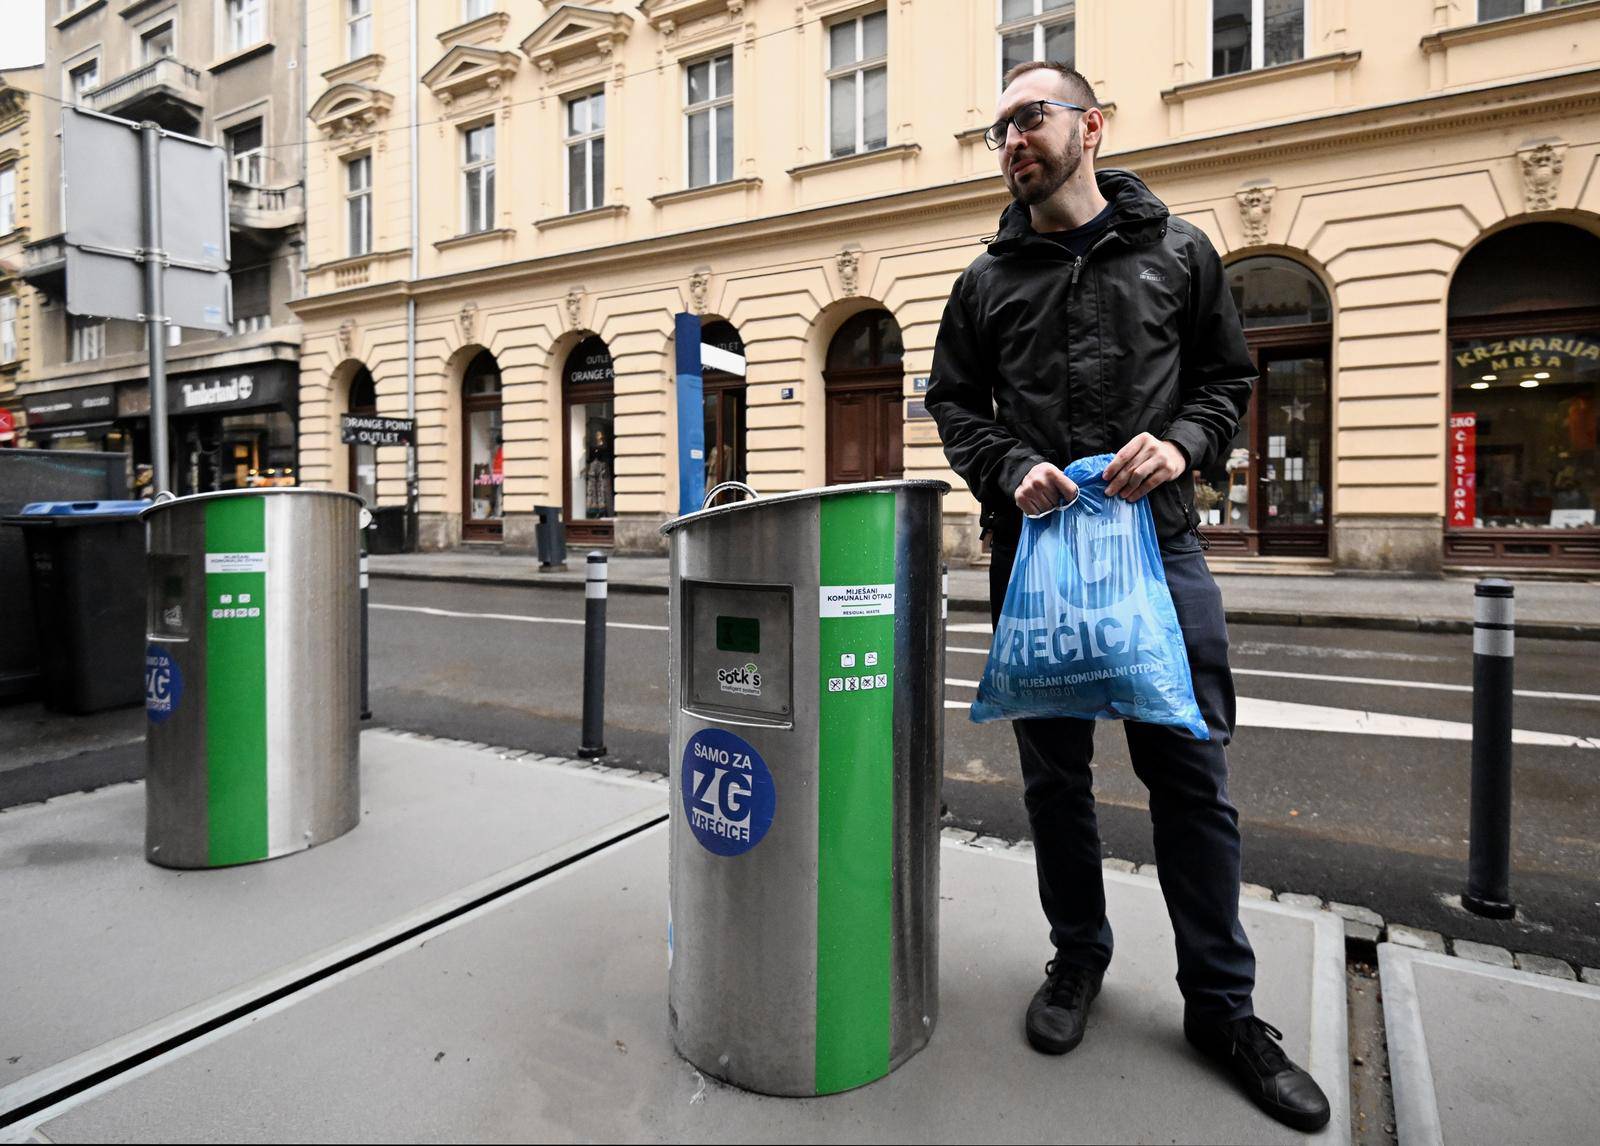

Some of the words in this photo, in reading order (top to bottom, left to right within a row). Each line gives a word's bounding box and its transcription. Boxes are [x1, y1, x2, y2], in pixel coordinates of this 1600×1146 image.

[1456, 338, 1600, 368] KRZNARIJA
[1491, 353, 1561, 371] MRŠA
[571, 369, 604, 382] ORANGE
[344, 416, 384, 429] ORANGE
[385, 420, 413, 431] POINT
[360, 431, 399, 442] OUTLET
[827, 594, 871, 602] KOMUNALNI
[846, 587, 878, 595] MIJEŠANI
[988, 613, 1153, 667] VREĆICA
[1018, 675, 1063, 690] MIJEŠANI
[1063, 666, 1128, 687] KOMUNALNI
[694, 742, 729, 765] SAMO
[732, 753, 753, 770] ZA
[692, 767, 753, 822] ZG
[692, 811, 751, 843] VREĆICE
